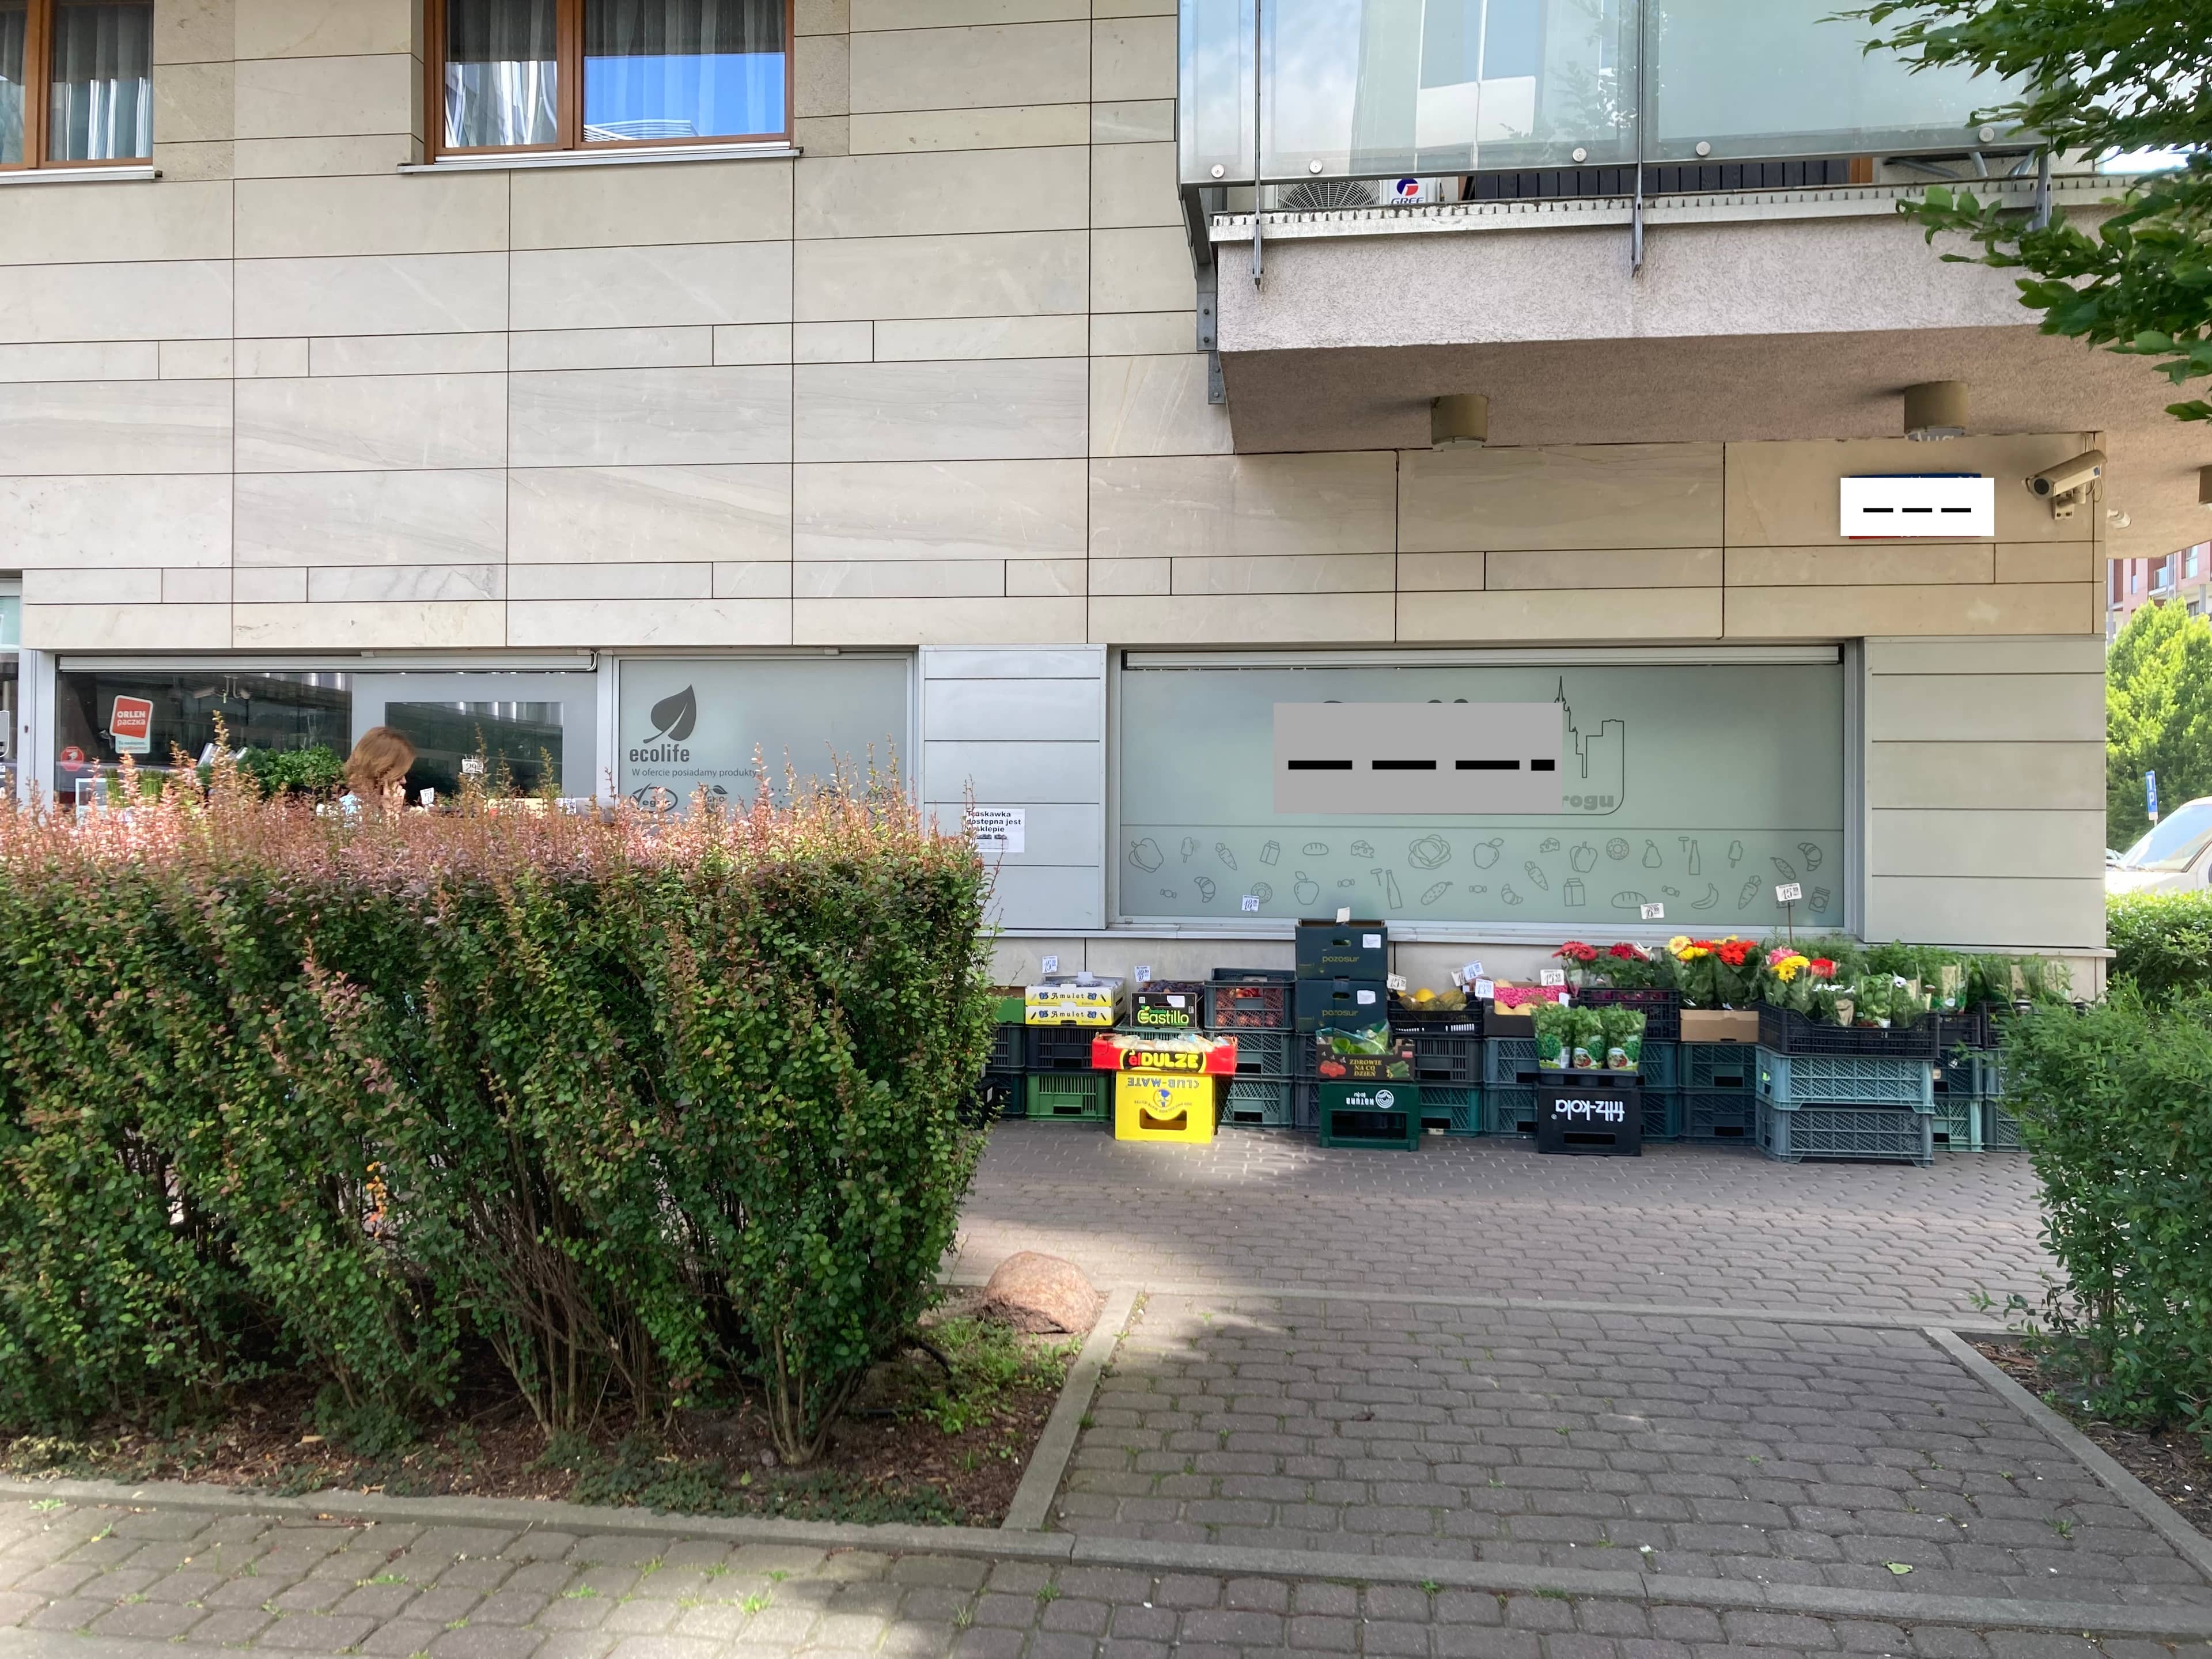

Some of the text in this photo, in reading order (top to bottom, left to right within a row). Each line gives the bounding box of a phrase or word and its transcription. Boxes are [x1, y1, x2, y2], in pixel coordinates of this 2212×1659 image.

[630, 744, 690, 762] ecolife
[672, 768, 717, 778] posiadamy
[719, 768, 757, 778] produkty
[1245, 899, 1252, 910] 18
[1127, 1077, 1199, 1088] CLUB-MATE
[1555, 1099, 1625, 1122] fritz-kola
